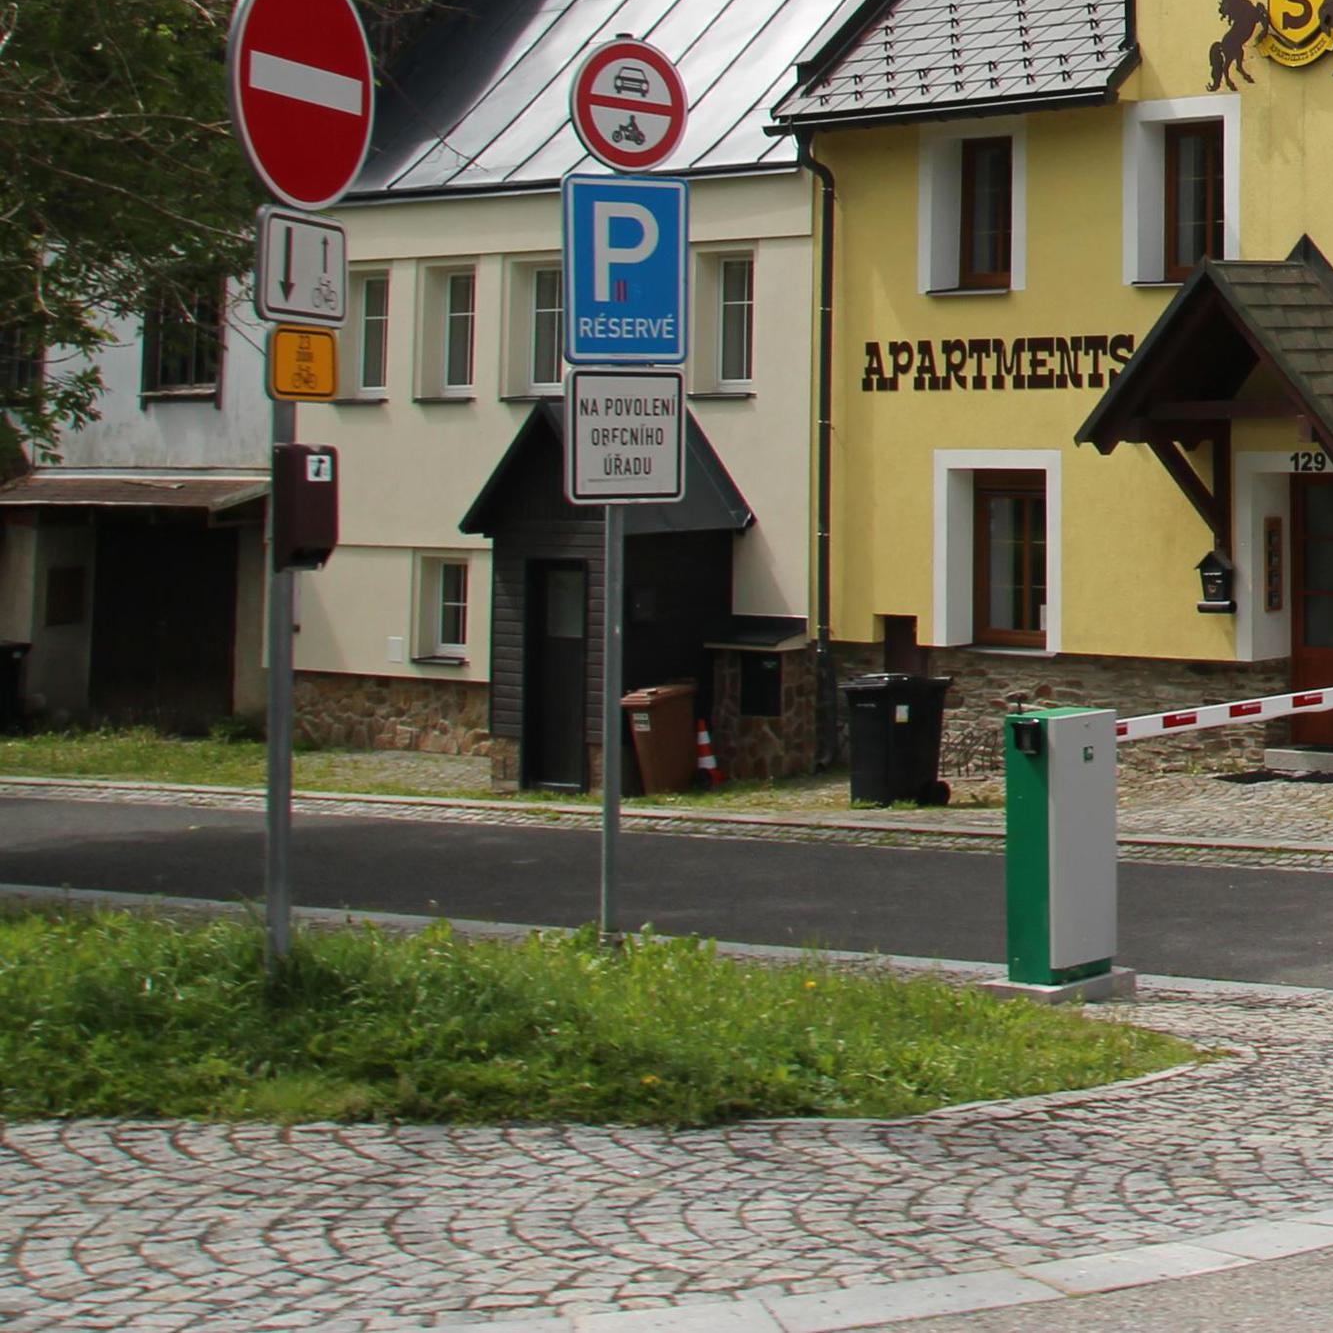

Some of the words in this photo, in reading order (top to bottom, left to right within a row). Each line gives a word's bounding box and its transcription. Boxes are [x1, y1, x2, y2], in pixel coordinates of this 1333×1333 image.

[593, 201, 660, 302] P
[579, 313, 675, 339] RÉSERVÉ
[862, 334, 1135, 391] APARTMENTS
[580, 398, 599, 417] NA
[605, 394, 676, 417] POVOLENÍ
[604, 453, 652, 476] ÚŘADU
[1290, 452, 1327, 471] 129
